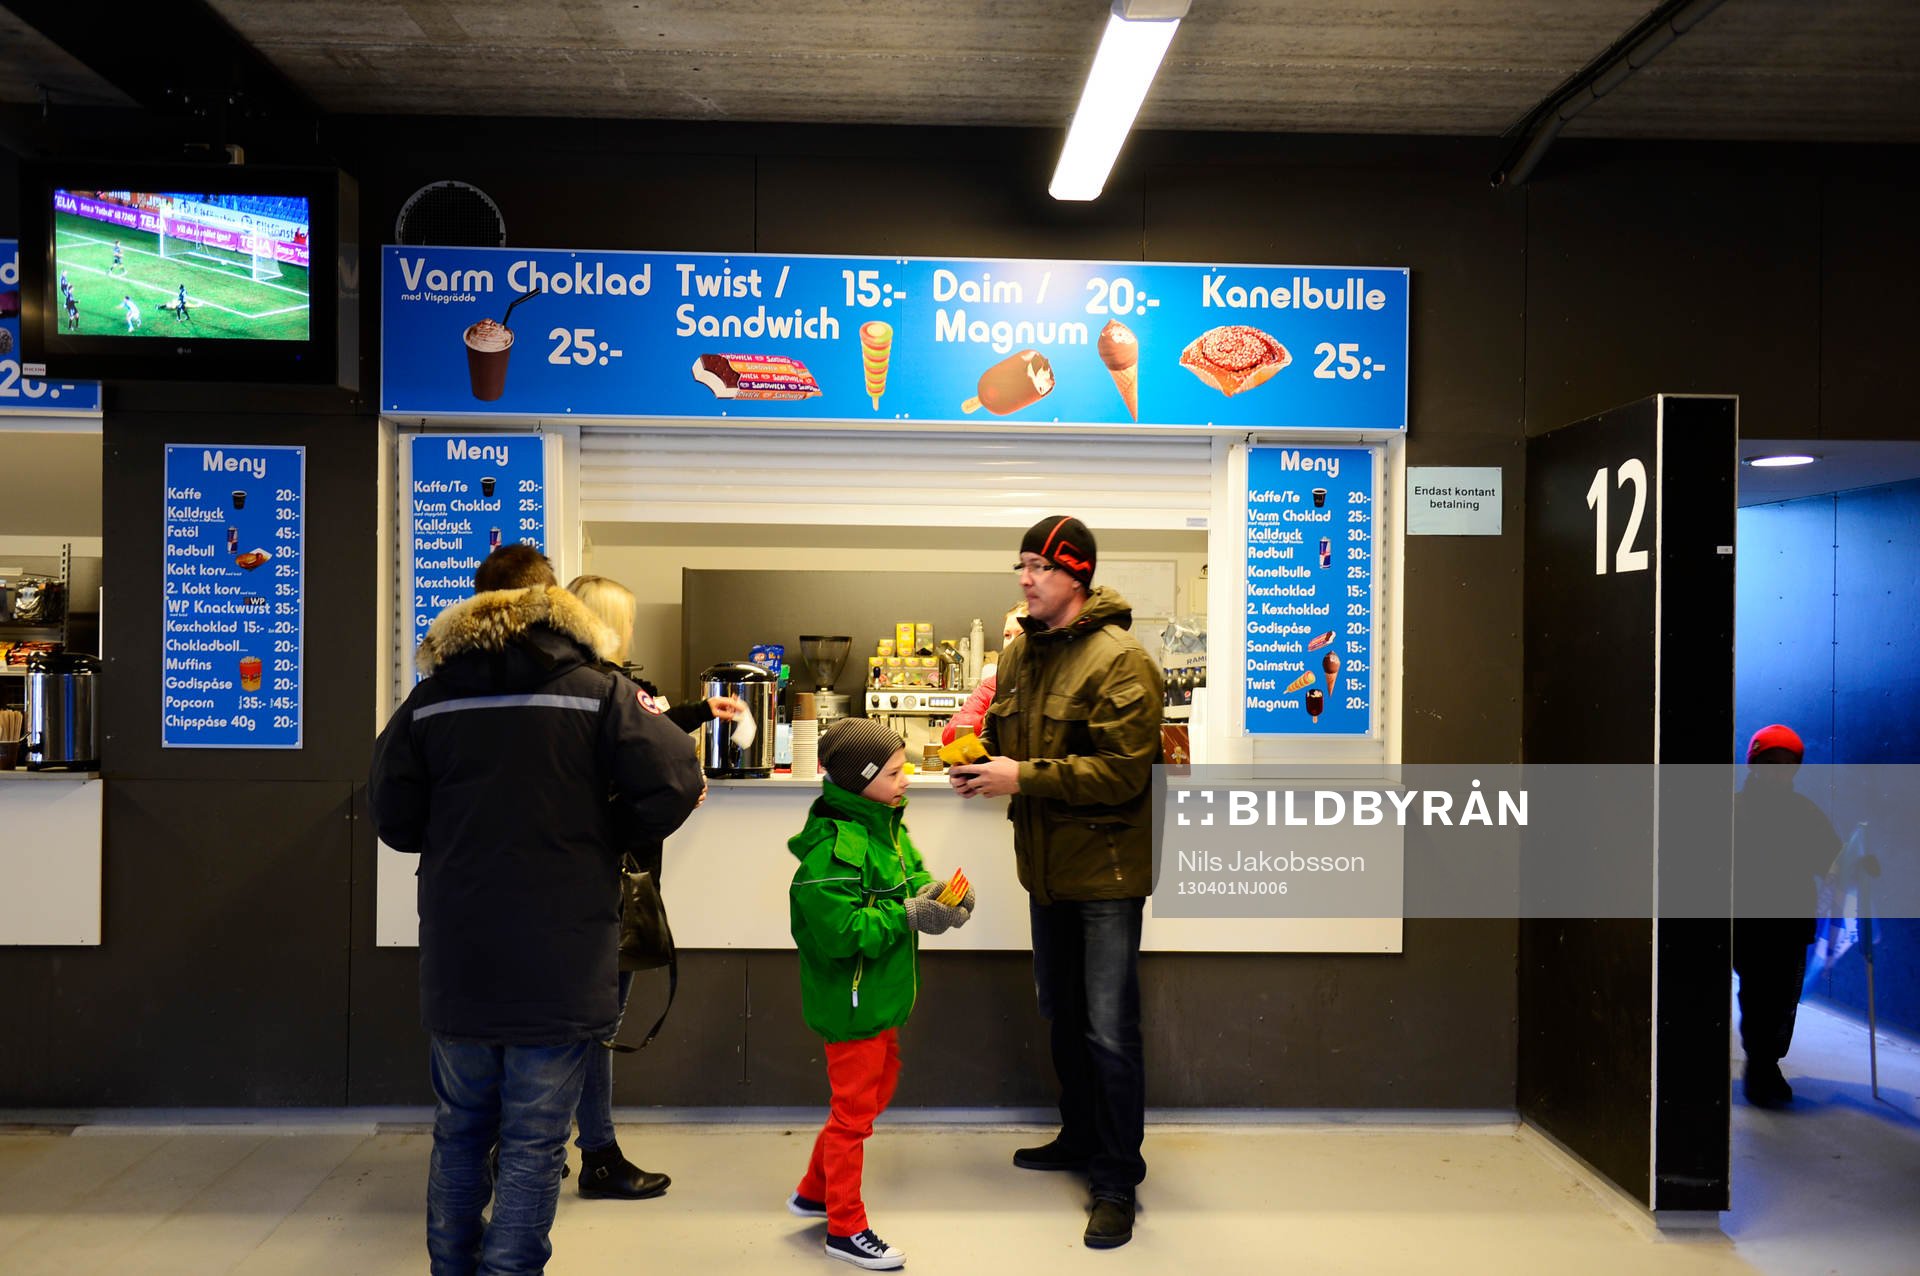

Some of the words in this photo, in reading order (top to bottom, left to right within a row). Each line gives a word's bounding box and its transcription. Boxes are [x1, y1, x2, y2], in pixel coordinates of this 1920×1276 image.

[400, 257, 493, 293] Varm
[507, 261, 651, 296] Choklad
[676, 263, 763, 297] Twist
[774, 265, 790, 298] /
[842, 269, 906, 308] 15:-
[933, 269, 1022, 304] Daim
[1037, 271, 1052, 304] /
[1202, 275, 1386, 311] Kanelbulle
[401, 292, 421, 301] med
[424, 292, 476, 304] Vispgrädde
[1085, 278, 1160, 316] 20:-
[676, 304, 840, 340] Sandwich
[935, 309, 1088, 353] Magnum
[548, 328, 623, 365] 25:-
[1313, 343, 1386, 380] 25:-
[447, 439, 508, 466] Meny
[203, 450, 266, 479] Meny
[1281, 450, 1340, 478] Meny
[414, 480, 468, 493] Kaffe/Te
[519, 480, 543, 492] 20:-
[1415, 486, 1451, 496] Endast
[1455, 487, 1495, 496] kontant
[168, 487, 201, 500] Kaffe
[275, 489, 300, 501] 20:-
[1248, 490, 1300, 503] Kaffe/Te
[1347, 492, 1371, 504] 20:-
[414, 500, 446, 511] Varm
[450, 499, 501, 511] Choklad
[519, 499, 543, 511] 25:-
[1430, 500, 1480, 511] betalning
[167, 506, 224, 522] Kalldryck
[275, 508, 300, 520] 30:-
[1248, 509, 1279, 521] Varm
[1282, 509, 1331, 522] Choklad
[1347, 510, 1371, 522] 25:-
[1586, 458, 1649, 576] 12
[167, 525, 198, 537] Fatöl
[275, 527, 300, 539] 45:-
[415, 518, 471, 533] Kalldryck
[519, 518, 544, 530] 30:-
[1248, 528, 1302, 543] Kalldryck
[1347, 529, 1371, 541] 30:-
[415, 537, 462, 550] Redbull
[167, 544, 214, 557] Redbull
[275, 546, 299, 558] 30:-
[1248, 546, 1293, 559] Redbull
[1347, 548, 1370, 560] 30:-
[167, 563, 196, 576] Kokt
[200, 563, 226, 576] korv
[275, 565, 298, 577] 25:-
[415, 557, 481, 569] Kanelbulle
[1248, 565, 1311, 578] Kanelbulle
[1347, 566, 1370, 578] 25:-
[166, 582, 178, 594] 2.
[182, 582, 211, 595] Kokt
[214, 582, 240, 595] korv
[275, 584, 298, 596] 35:-
[1247, 584, 1316, 597] Kexchoklad
[1347, 585, 1367, 597] 15:-
[168, 599, 189, 613] WP
[194, 600, 270, 615] Knackwurst
[275, 603, 298, 615] 35:-
[250, 597, 265, 605] WP
[1247, 602, 1258, 615] 2.
[1262, 602, 1330, 615] Kexchoklad
[1346, 604, 1370, 616] 20:-
[167, 620, 237, 632] Kexchoklad
[243, 621, 264, 633] 15:-
[275, 621, 299, 633] 20:-
[1247, 621, 1311, 637] Godispåse
[1346, 622, 1370, 634] 20:-
[166, 639, 239, 652] Chokladboll
[274, 640, 298, 652] 20:-
[1247, 640, 1302, 653] Sandwich
[1346, 641, 1366, 653] 15:-
[166, 657, 212, 670] Muffins
[274, 659, 298, 671] 20:-
[1247, 659, 1304, 671] Daimstrut
[1346, 660, 1369, 672] 20:-
[166, 676, 232, 692] Godispåse
[274, 678, 298, 690] 20:-
[1246, 678, 1275, 690] Twist
[1346, 679, 1366, 690] 15:-
[165, 695, 214, 711] Popcorn
[243, 696, 266, 709] 35:-
[273, 697, 298, 709] 45:-
[1246, 696, 1299, 712] Magnum
[1346, 697, 1369, 709] 20:-
[165, 714, 227, 730] Chipspåse
[231, 715, 256, 731] 40g
[274, 716, 298, 728] 20:-
